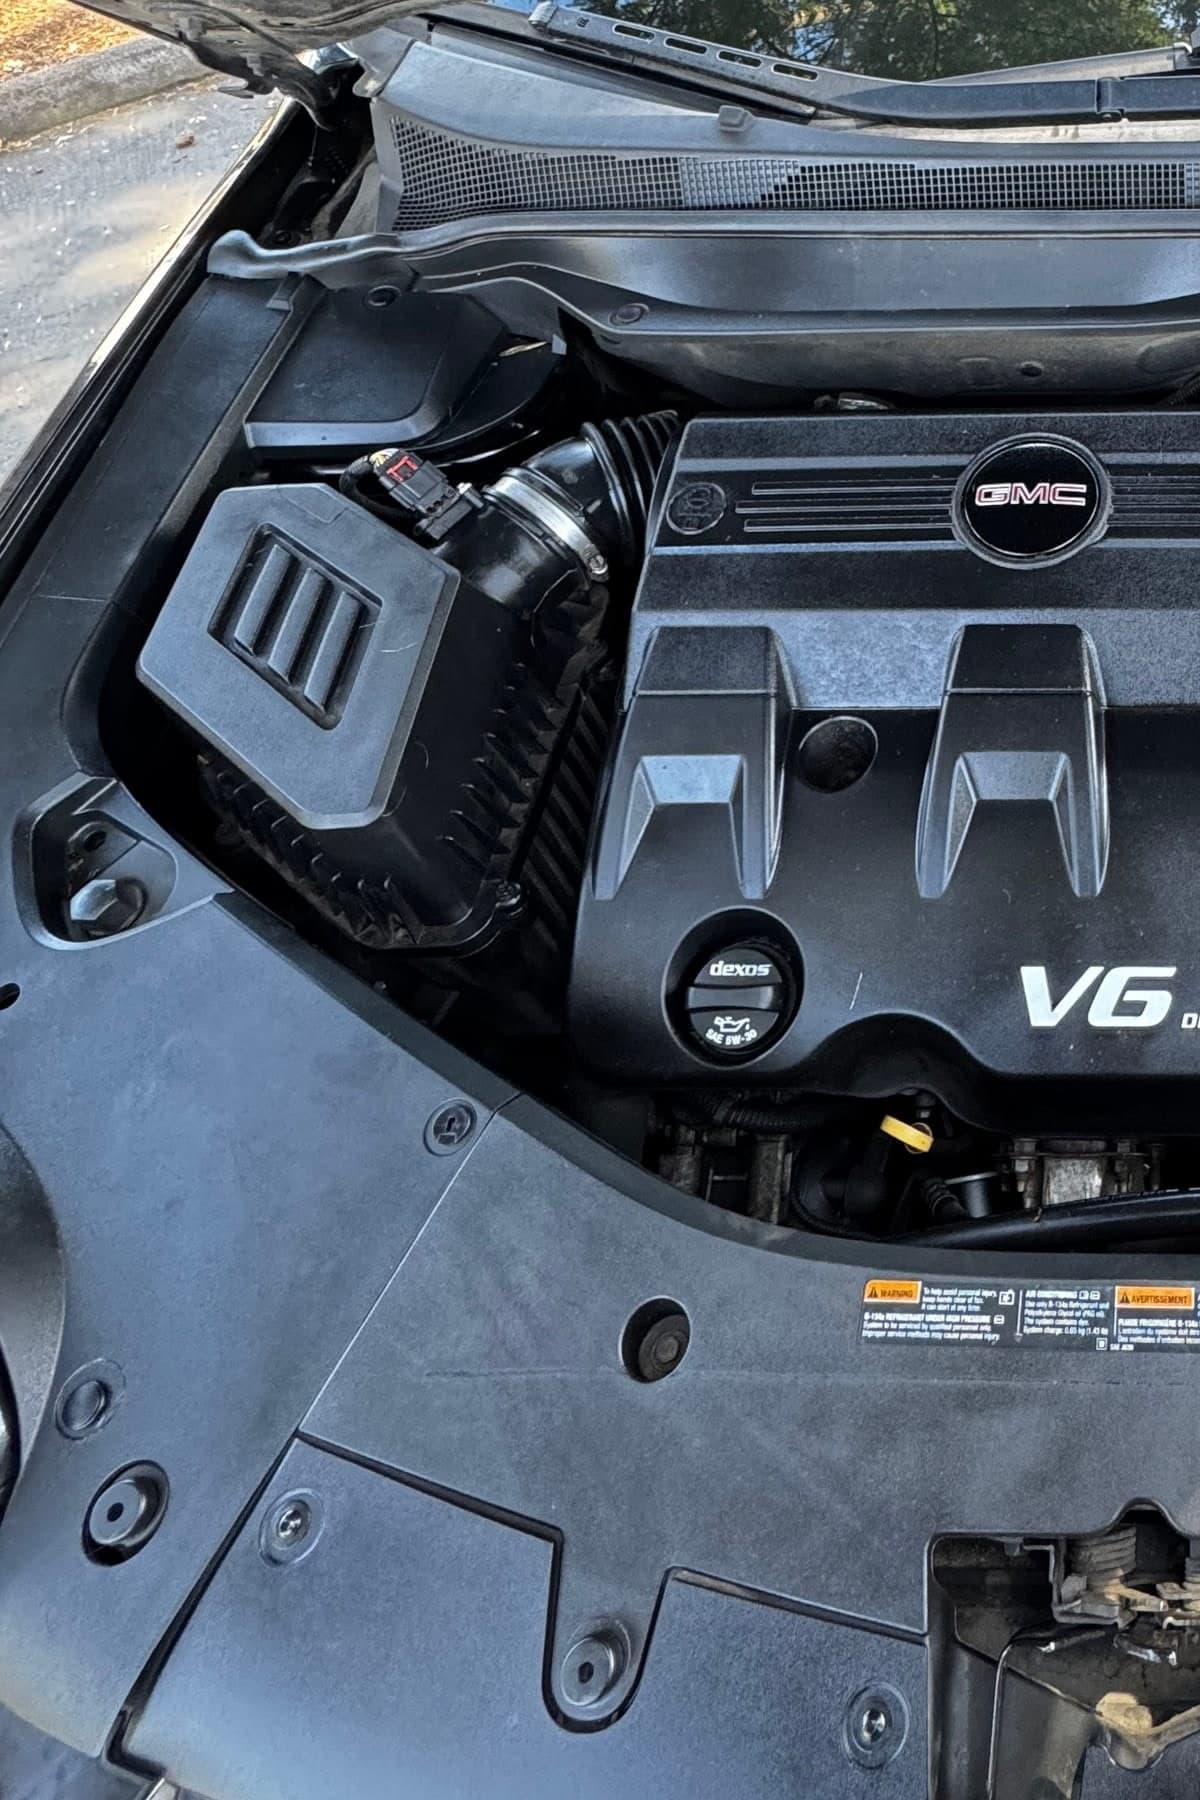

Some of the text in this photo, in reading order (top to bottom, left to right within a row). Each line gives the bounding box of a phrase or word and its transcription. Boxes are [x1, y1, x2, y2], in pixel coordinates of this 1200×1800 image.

[975, 482, 1087, 507] GMC
[709, 961, 773, 977] dexos
[1020, 966, 1177, 1028] V6
[705, 1028, 723, 1045] SAE
